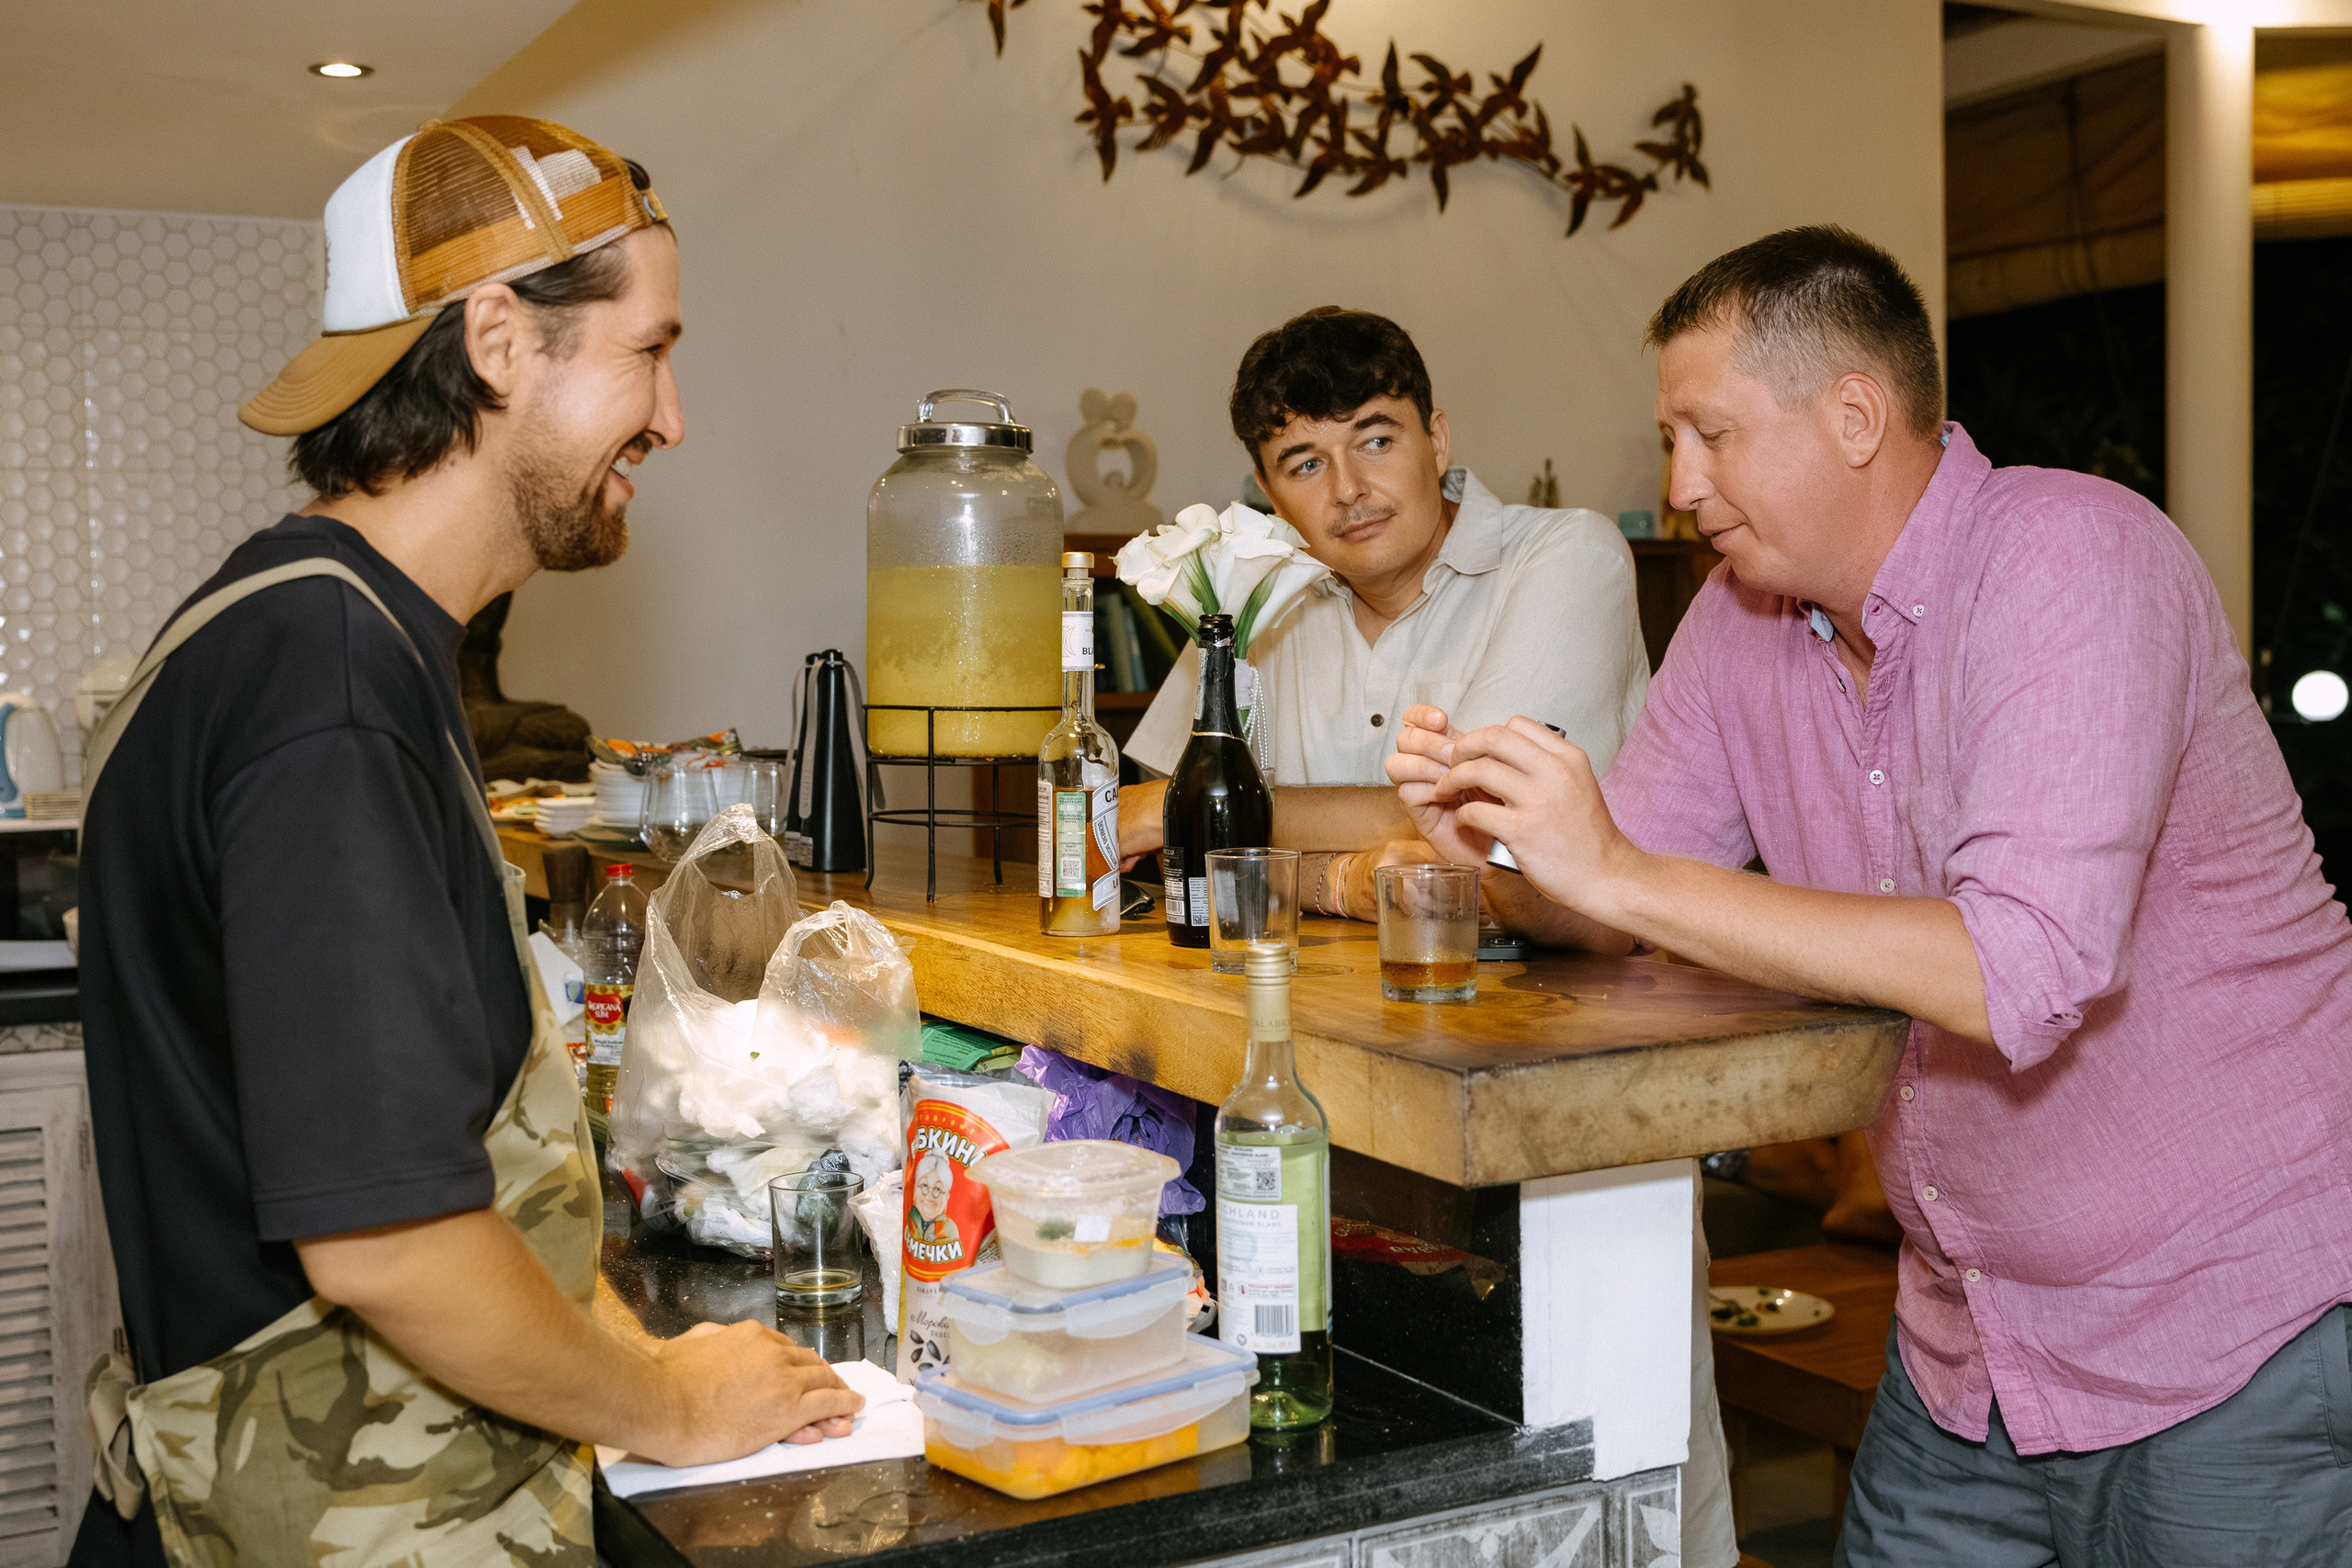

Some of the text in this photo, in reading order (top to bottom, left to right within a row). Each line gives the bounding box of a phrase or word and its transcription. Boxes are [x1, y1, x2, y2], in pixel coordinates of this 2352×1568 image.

[588, 999, 622, 1013] TROPICANA
[594, 1010, 609, 1019] SLIM
[919, 1113, 975, 1135] ТБОРНЫЕ
